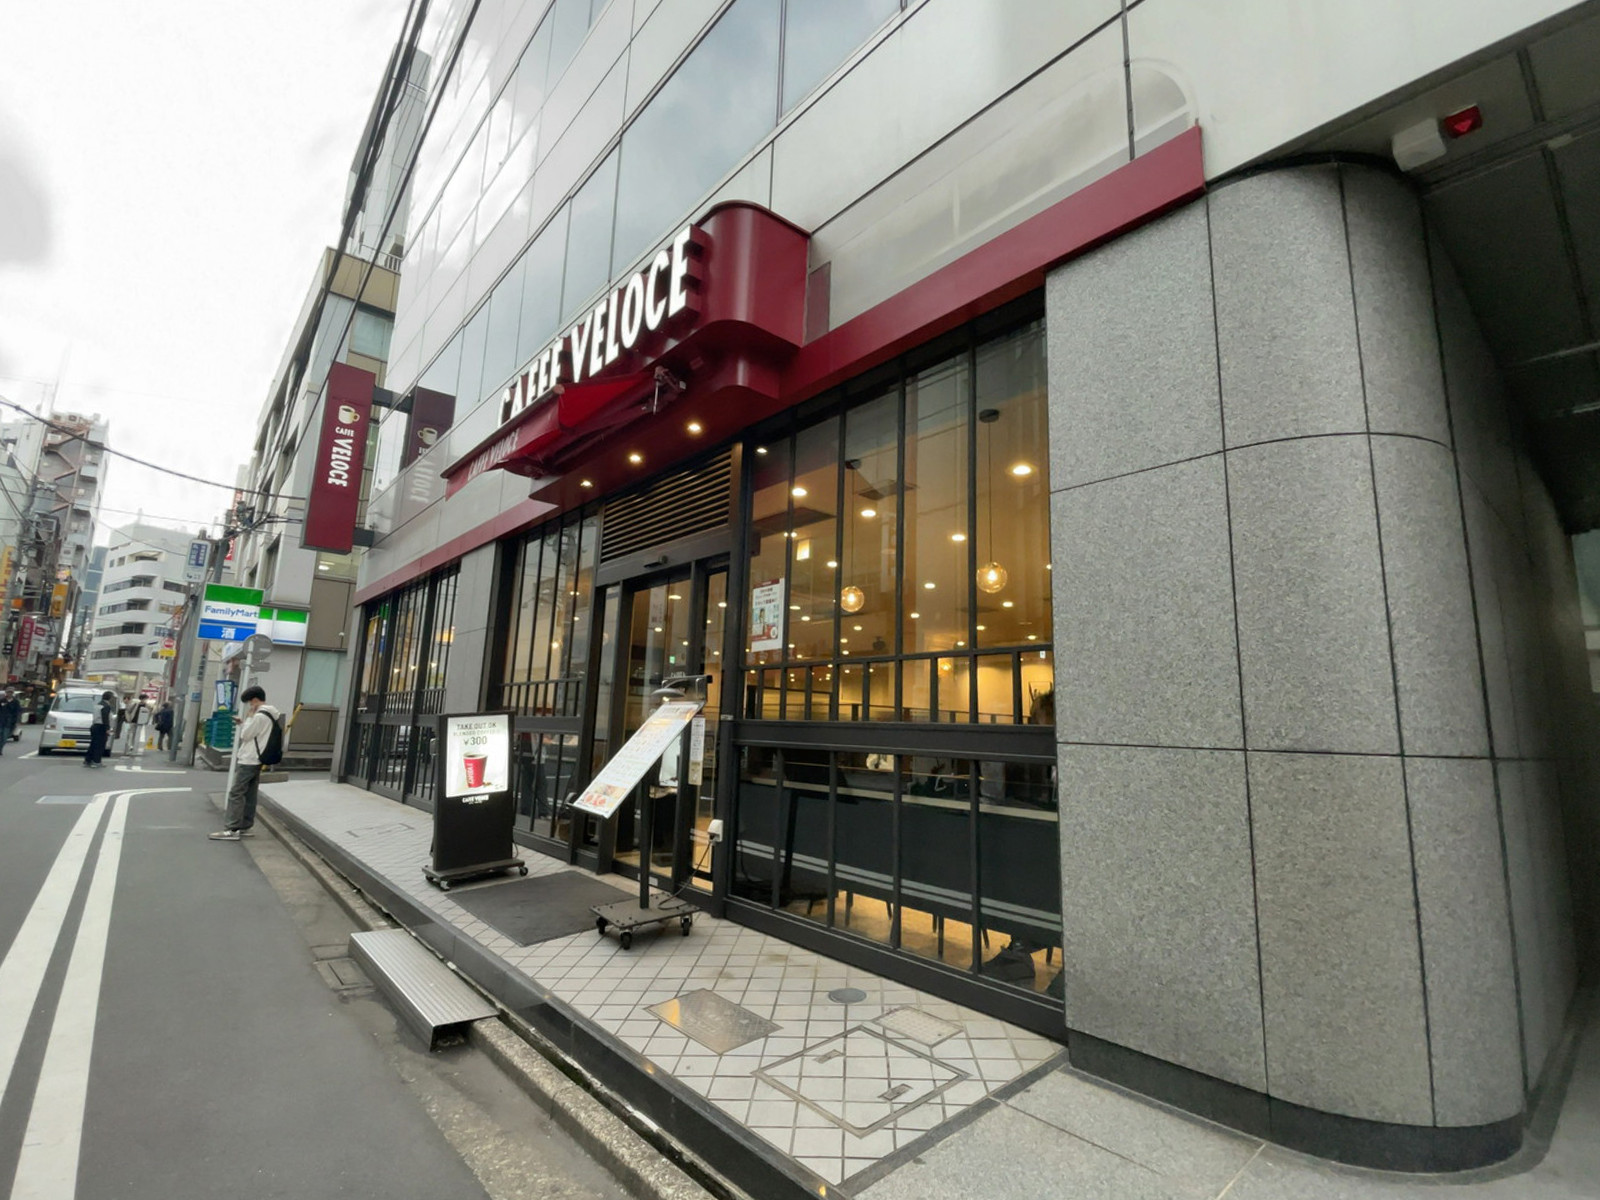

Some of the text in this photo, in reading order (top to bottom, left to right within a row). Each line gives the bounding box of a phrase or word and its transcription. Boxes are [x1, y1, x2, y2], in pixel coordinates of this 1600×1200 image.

[571, 225, 690, 384] VELOCE
[327, 438, 354, 487] VELOCE
[204, 605, 258, 618] FamilyMart
[221, 627, 236, 640] 酒
